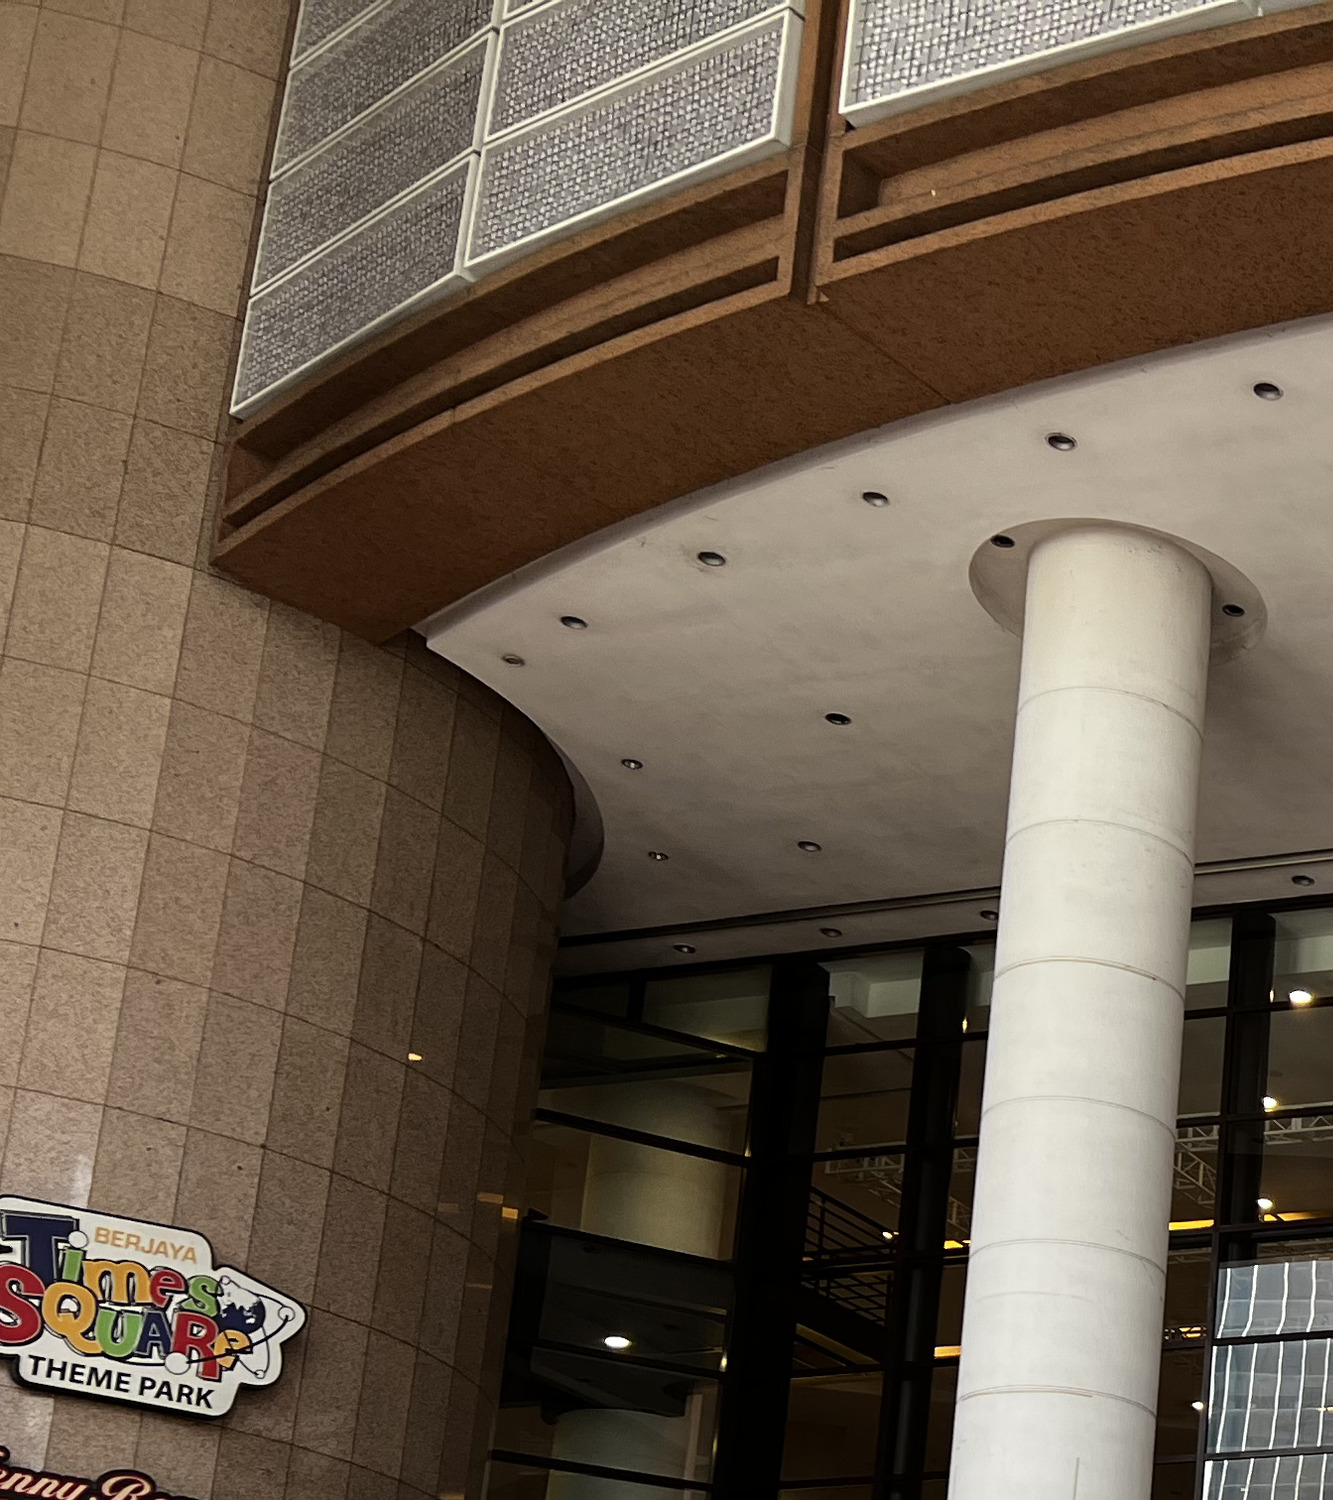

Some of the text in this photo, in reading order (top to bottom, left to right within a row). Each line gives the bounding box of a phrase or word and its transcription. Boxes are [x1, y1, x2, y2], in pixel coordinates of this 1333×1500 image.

[94, 1226, 198, 1265] BERJAYA
[28, 1355, 215, 1409] THEME PARK
